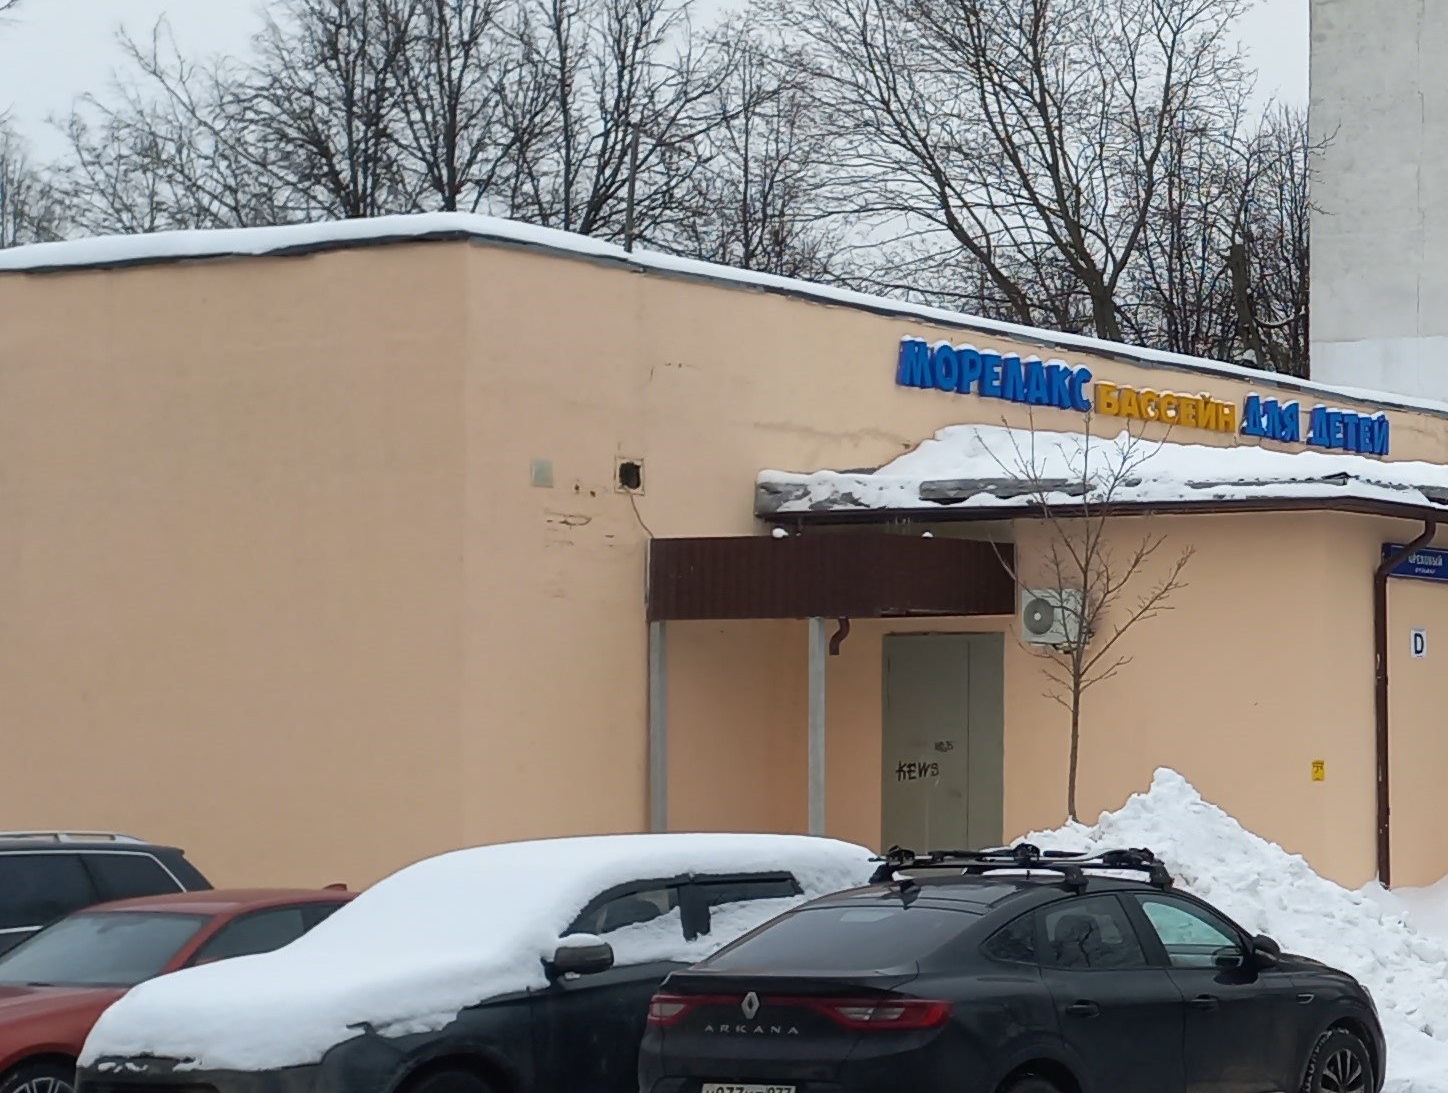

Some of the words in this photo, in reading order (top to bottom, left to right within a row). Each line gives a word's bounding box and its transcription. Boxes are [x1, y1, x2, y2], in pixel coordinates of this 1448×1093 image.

[897, 339, 1092, 412] МОРЕЛАКС
[1094, 383, 1236, 433] БАССЕЙН
[1241, 394, 1300, 442] ДЛЯ
[1307, 404, 1389, 455] ДЕТЕЙ
[1414, 633, 1424, 654] D
[704, 1024, 799, 1034] ARKANA
